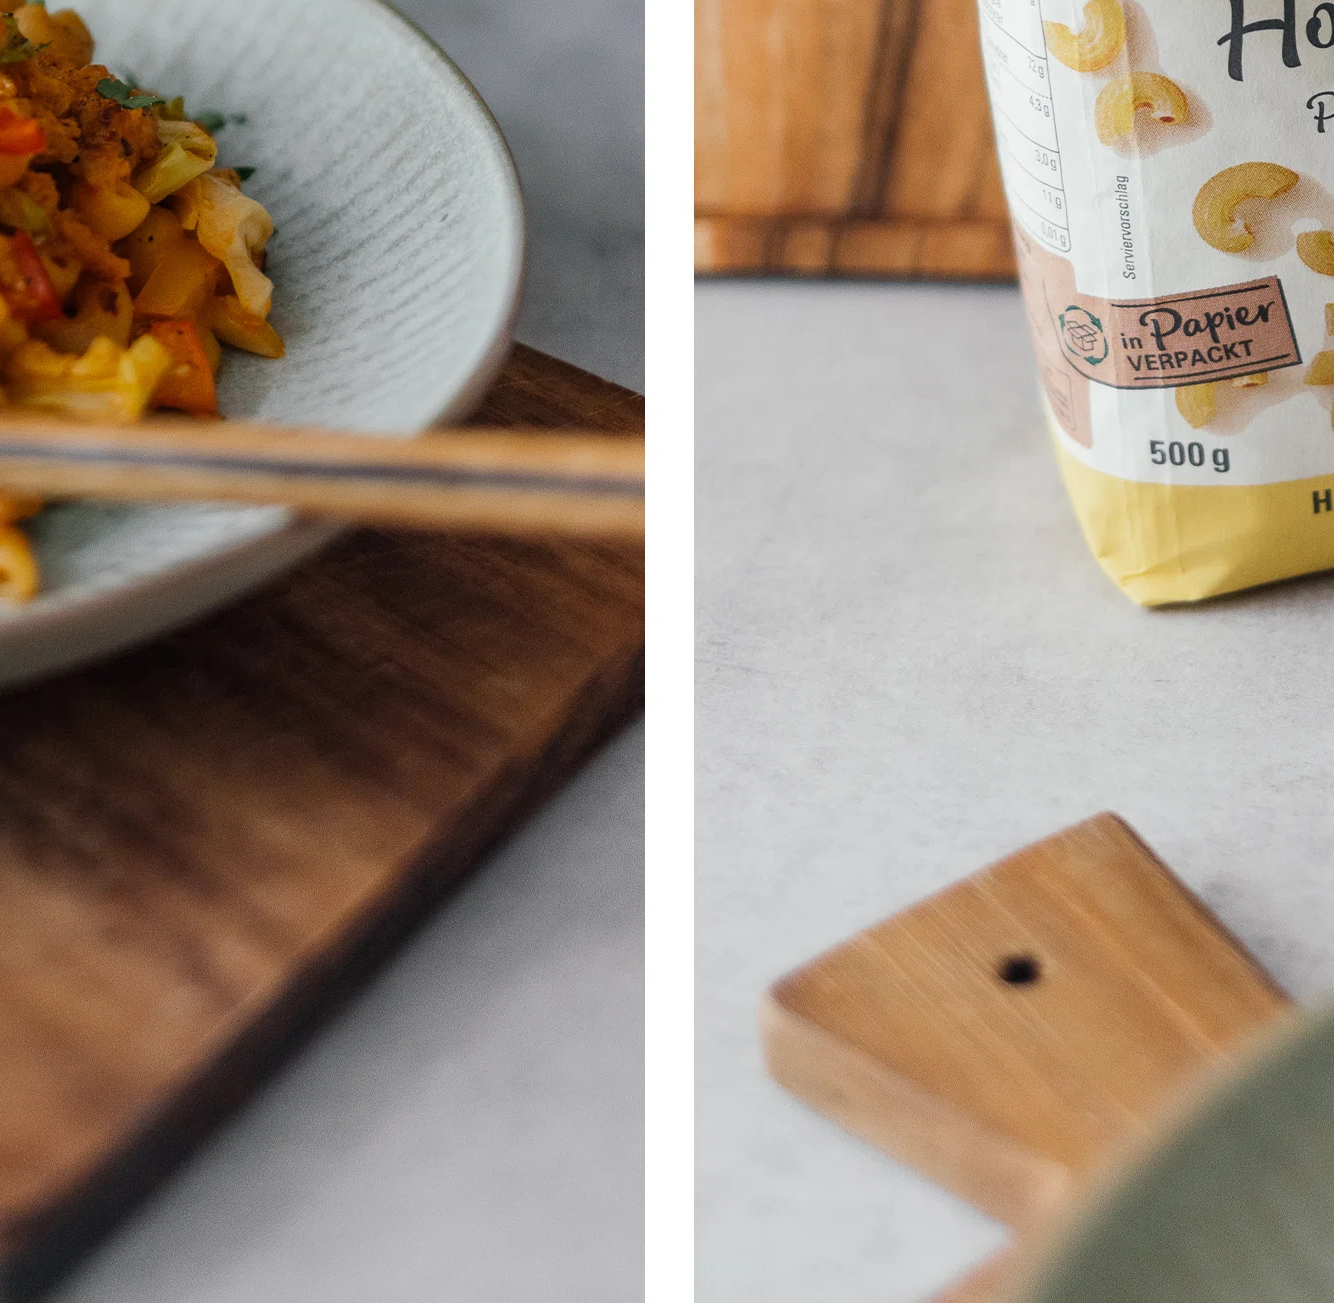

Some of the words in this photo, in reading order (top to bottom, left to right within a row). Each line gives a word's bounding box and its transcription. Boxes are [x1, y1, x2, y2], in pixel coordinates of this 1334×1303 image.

[1027, 55, 1038, 74] 72
[1029, 95, 1042, 113] 4,3
[1043, 104, 1050, 118] g
[1035, 149, 1048, 166] 3,0
[1050, 157, 1057, 172] g
[1042, 188, 1053, 205] 11
[1055, 195, 1062, 210] g
[1041, 221, 1058, 242] 0,01
[1114, 174, 1136, 281] Serviervorschlag
[1120, 332, 1143, 350] in
[1139, 299, 1276, 352] Papier
[1126, 339, 1254, 373] VERPACKT
[1149, 439, 1206, 467] 500
[1212, 446, 1231, 474] g
